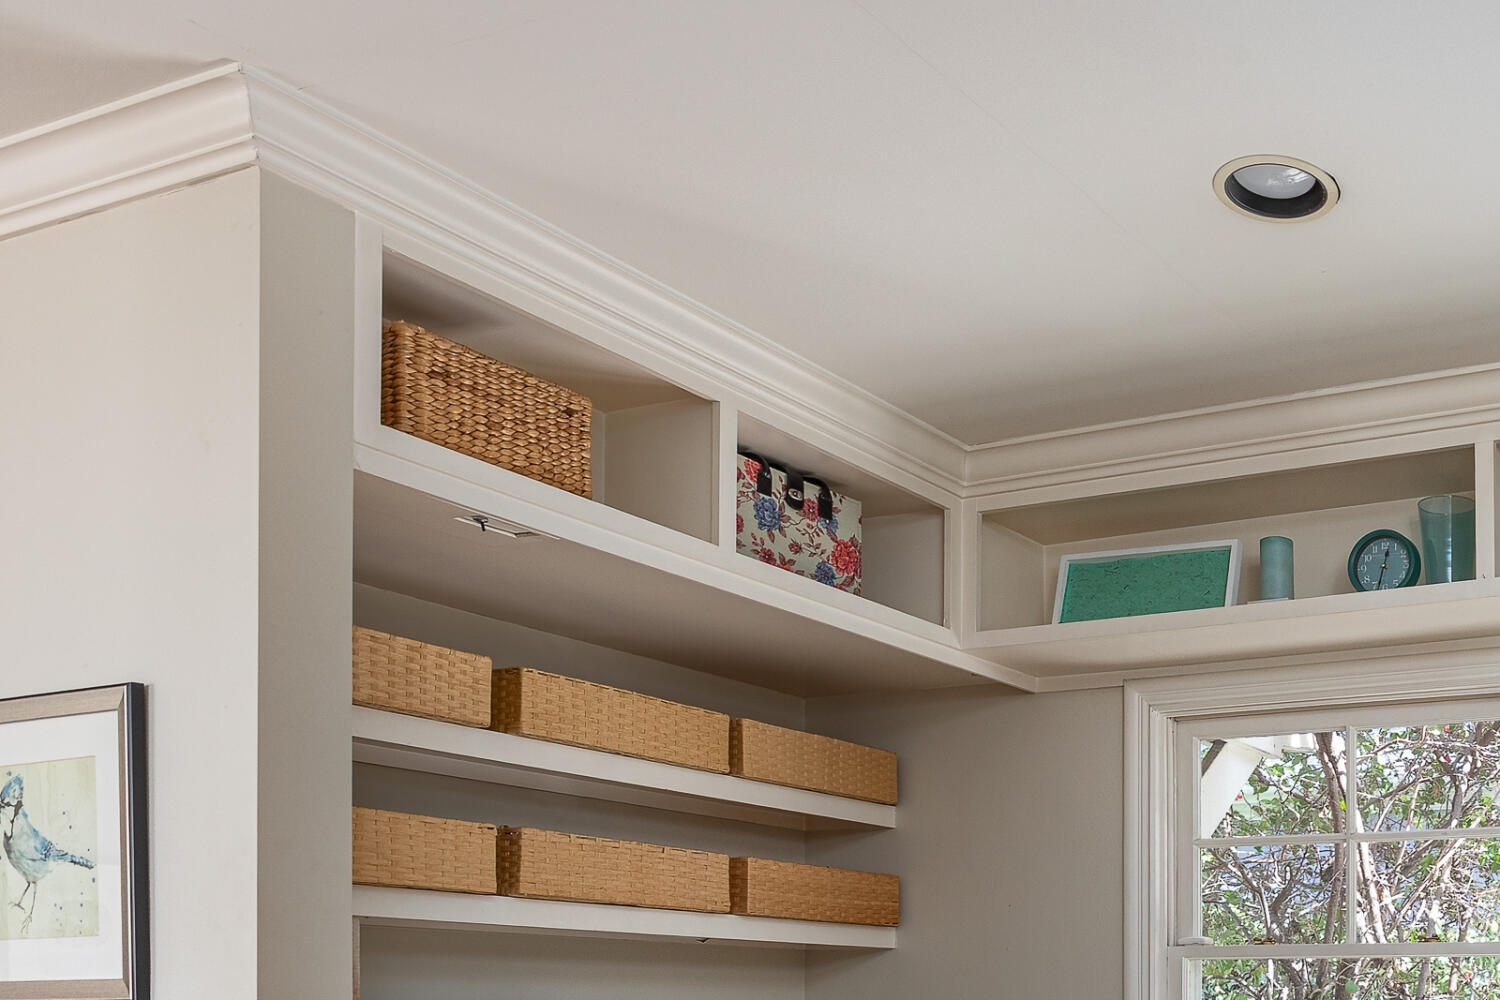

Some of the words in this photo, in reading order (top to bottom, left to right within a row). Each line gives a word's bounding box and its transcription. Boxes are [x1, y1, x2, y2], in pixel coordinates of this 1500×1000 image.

[1400, 549, 1407, 558] 2
[1364, 554, 1373, 562] 10
[1361, 565, 1367, 573] 9
[1364, 575, 1370, 583] 8
